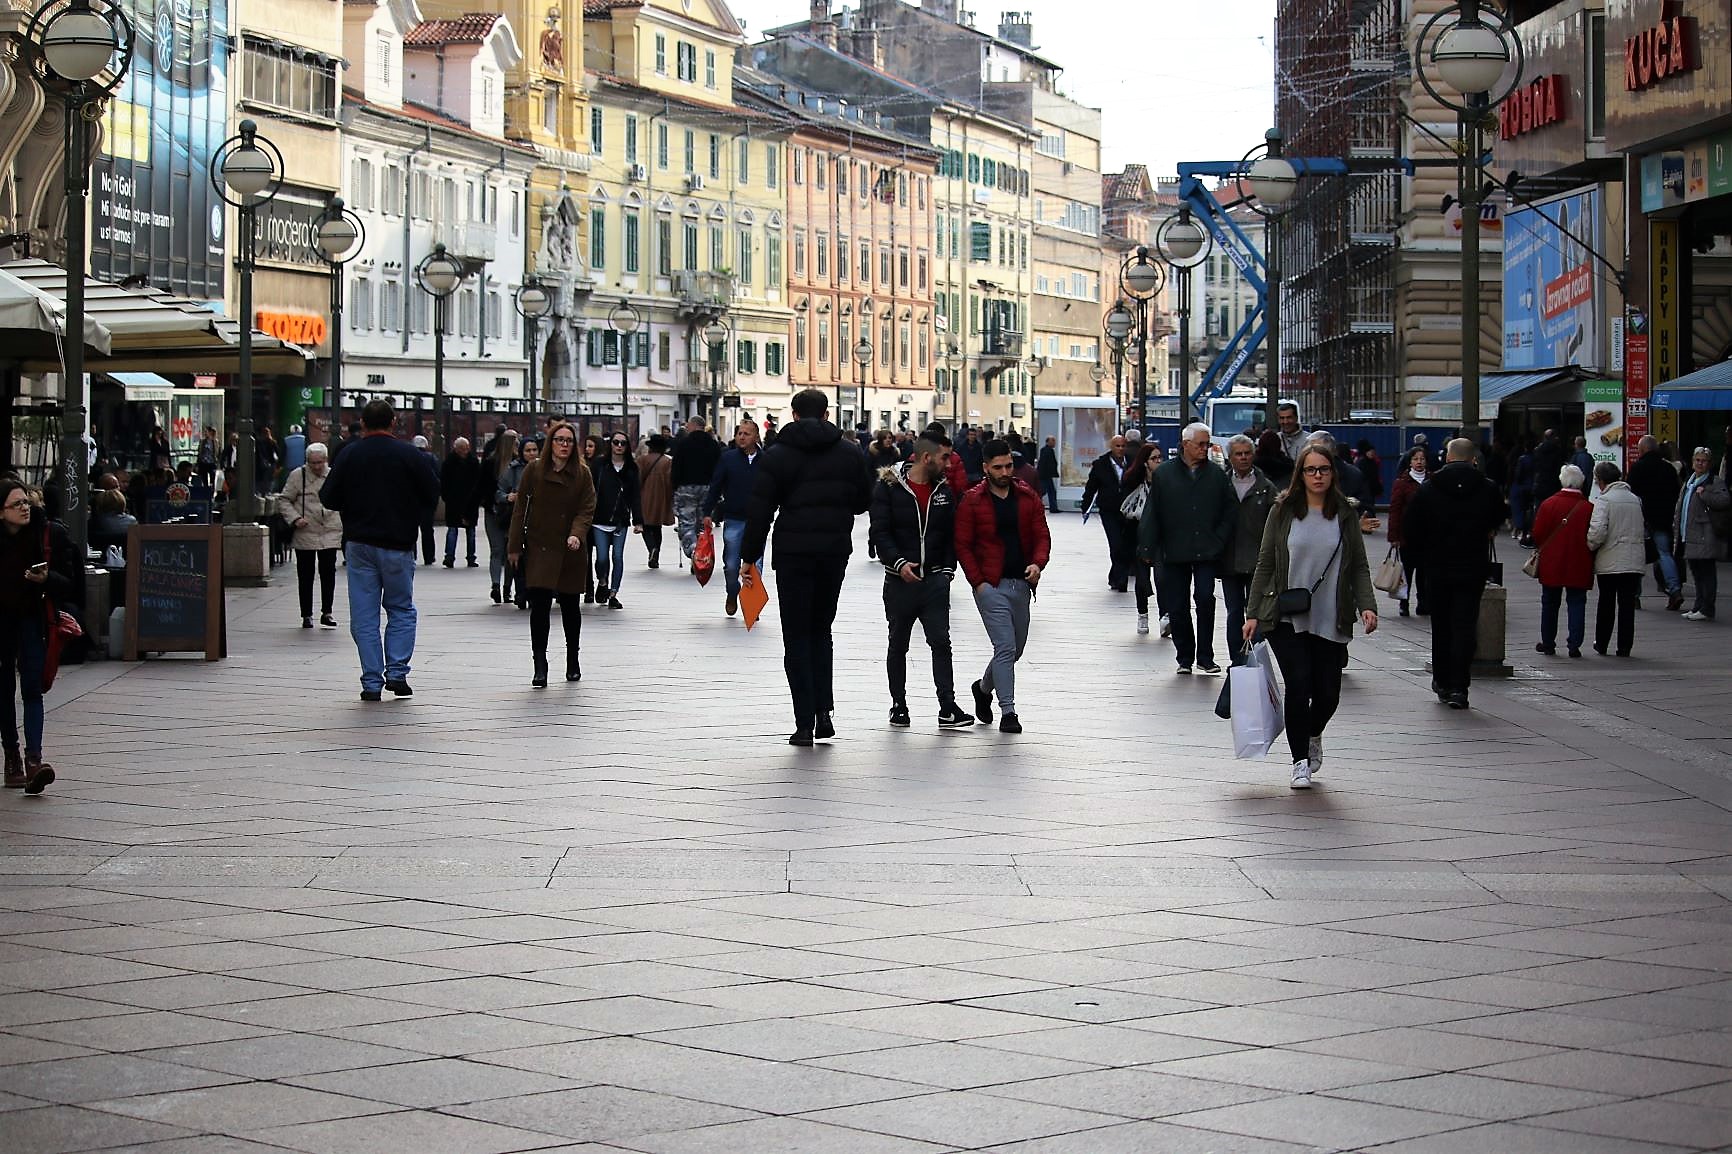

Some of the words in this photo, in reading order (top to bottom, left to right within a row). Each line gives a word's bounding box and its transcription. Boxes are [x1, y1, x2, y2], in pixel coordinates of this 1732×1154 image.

[1500, 75, 1559, 141] ROBNA
[1659, 229, 1669, 319] HAPPY
[258, 312, 327, 345] KORZO
[1659, 329, 1671, 384] HOM
[367, 374, 386, 385] ZARA
[1587, 387, 1605, 395] FOOD
[1593, 452, 1617, 461] Snack
